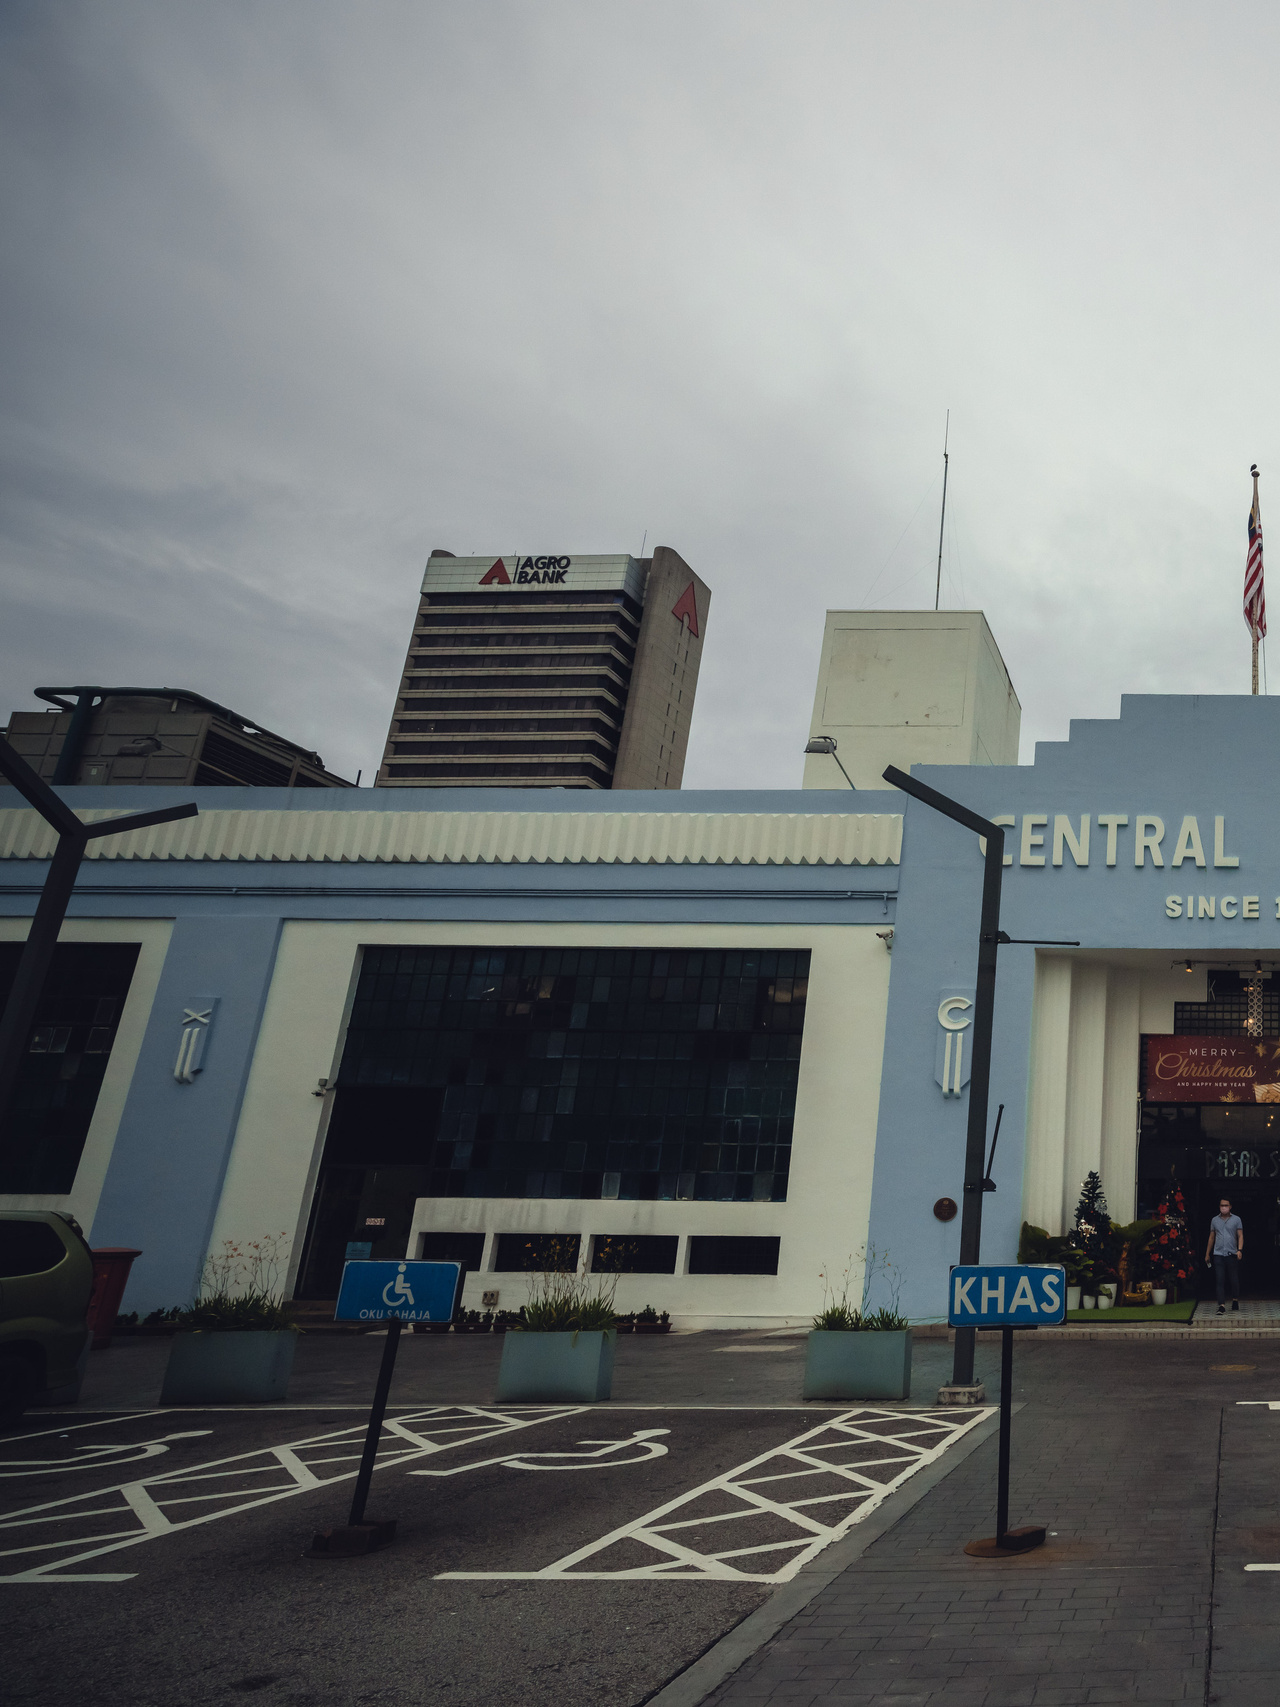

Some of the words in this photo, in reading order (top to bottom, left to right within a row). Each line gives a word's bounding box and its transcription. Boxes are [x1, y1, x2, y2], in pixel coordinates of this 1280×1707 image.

[520, 556, 571, 570] AGRO
[517, 570, 568, 584] BANK
[1165, 895, 1260, 919] SINCE
[1189, 1048, 1237, 1056] MERRY
[1155, 1052, 1257, 1080] Christmas
[1205, 1150, 1260, 1177] PASAR
[953, 1274, 1061, 1315] KHAS
[359, 1309, 384, 1319] OKU
[387, 1309, 431, 1320] SAHAJA
